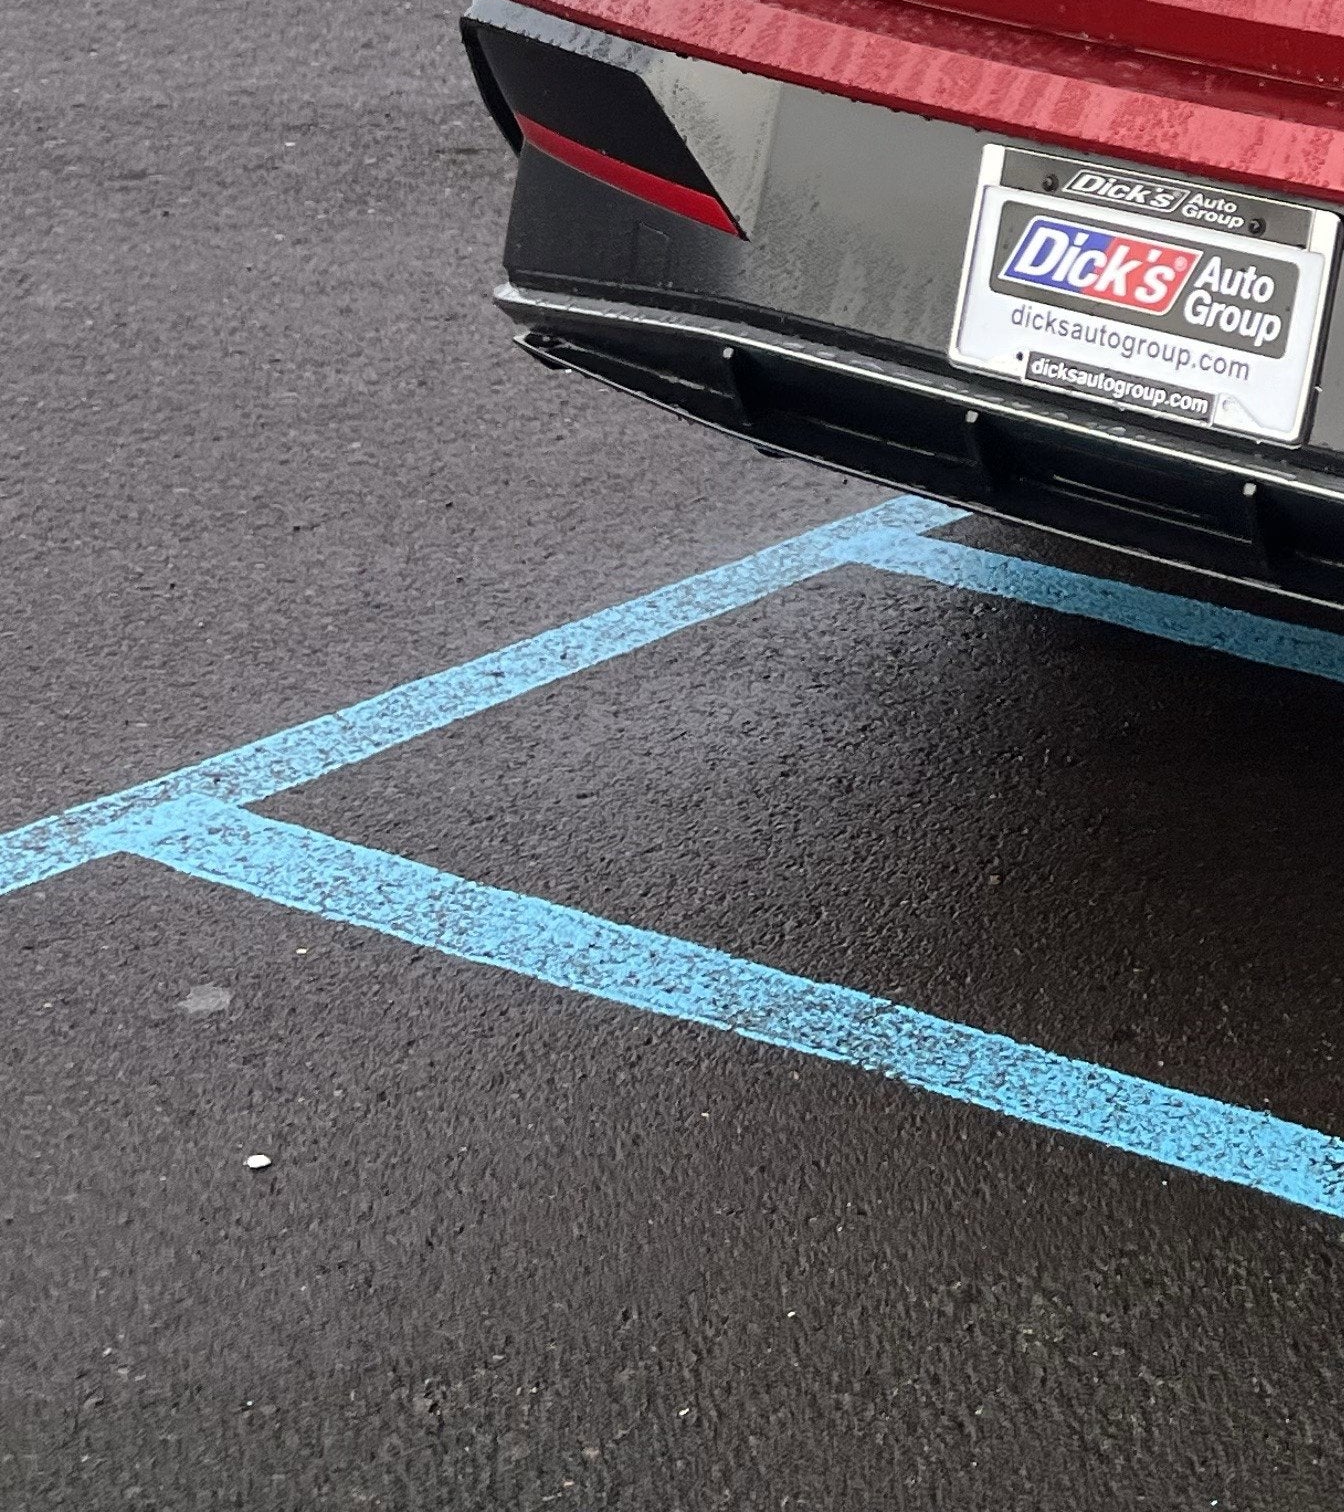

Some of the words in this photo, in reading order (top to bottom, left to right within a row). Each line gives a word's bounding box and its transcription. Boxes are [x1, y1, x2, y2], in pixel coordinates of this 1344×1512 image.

[1071, 174, 1175, 209] Dick's
[1181, 204, 1245, 229] Group
[1189, 193, 1238, 213] Auto
[1012, 226, 1176, 306] Dick's
[1194, 256, 1275, 303] Auto
[1011, 304, 1251, 382] dicksautogroup.com
[1183, 292, 1282, 348] Group
[1030, 357, 1210, 415] dicksautogroup.com
